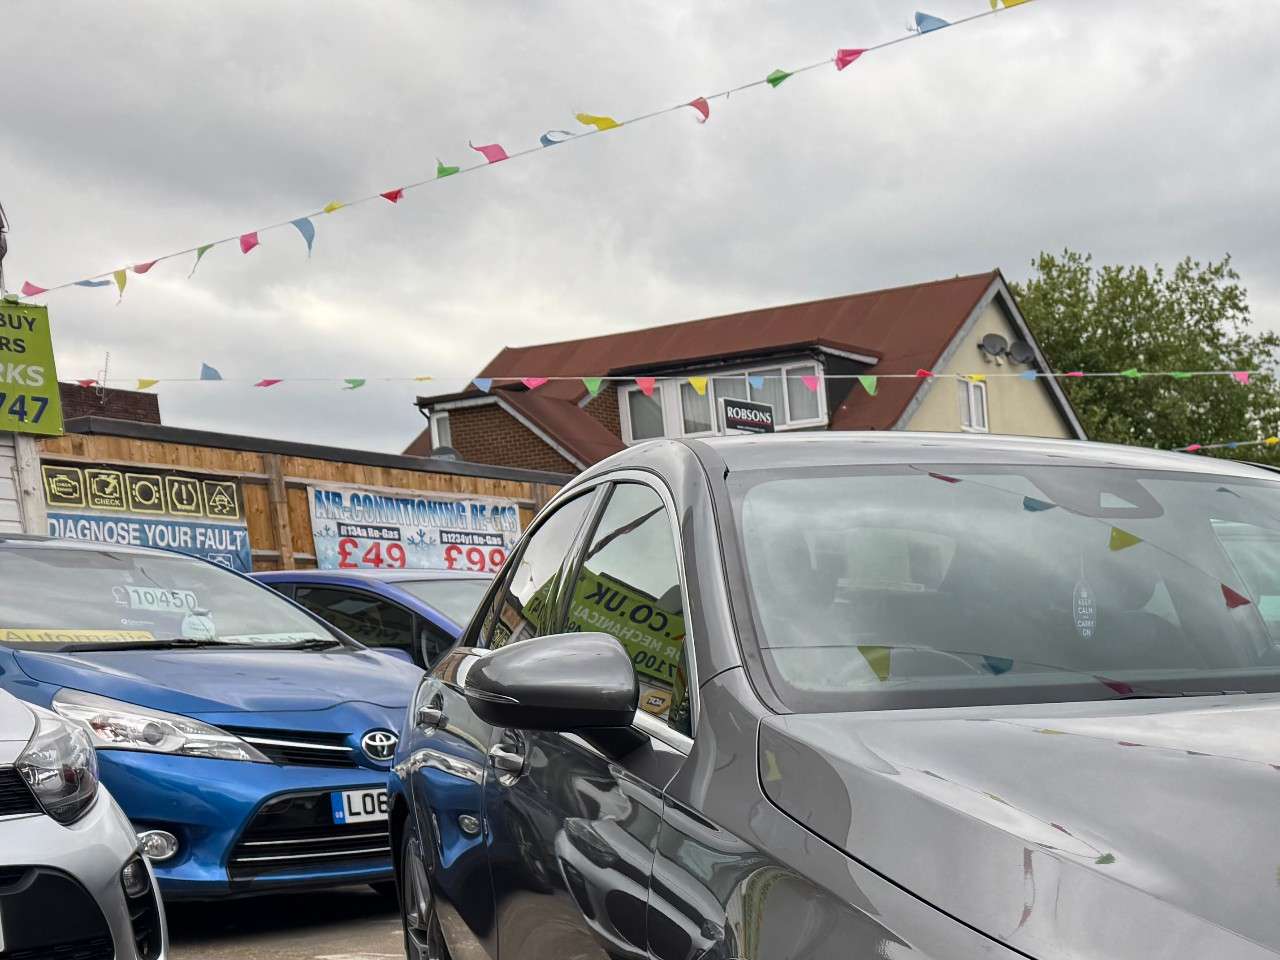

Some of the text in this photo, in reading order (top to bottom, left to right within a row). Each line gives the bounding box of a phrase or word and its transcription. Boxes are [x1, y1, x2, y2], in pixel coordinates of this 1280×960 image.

[727, 406, 772, 424] ROBSONS
[94, 497, 121, 506] CHECK
[48, 519, 248, 551] DIAGNOSE YOUR FAULT
[337, 537, 407, 569] £49
[443, 543, 507, 573] £99
